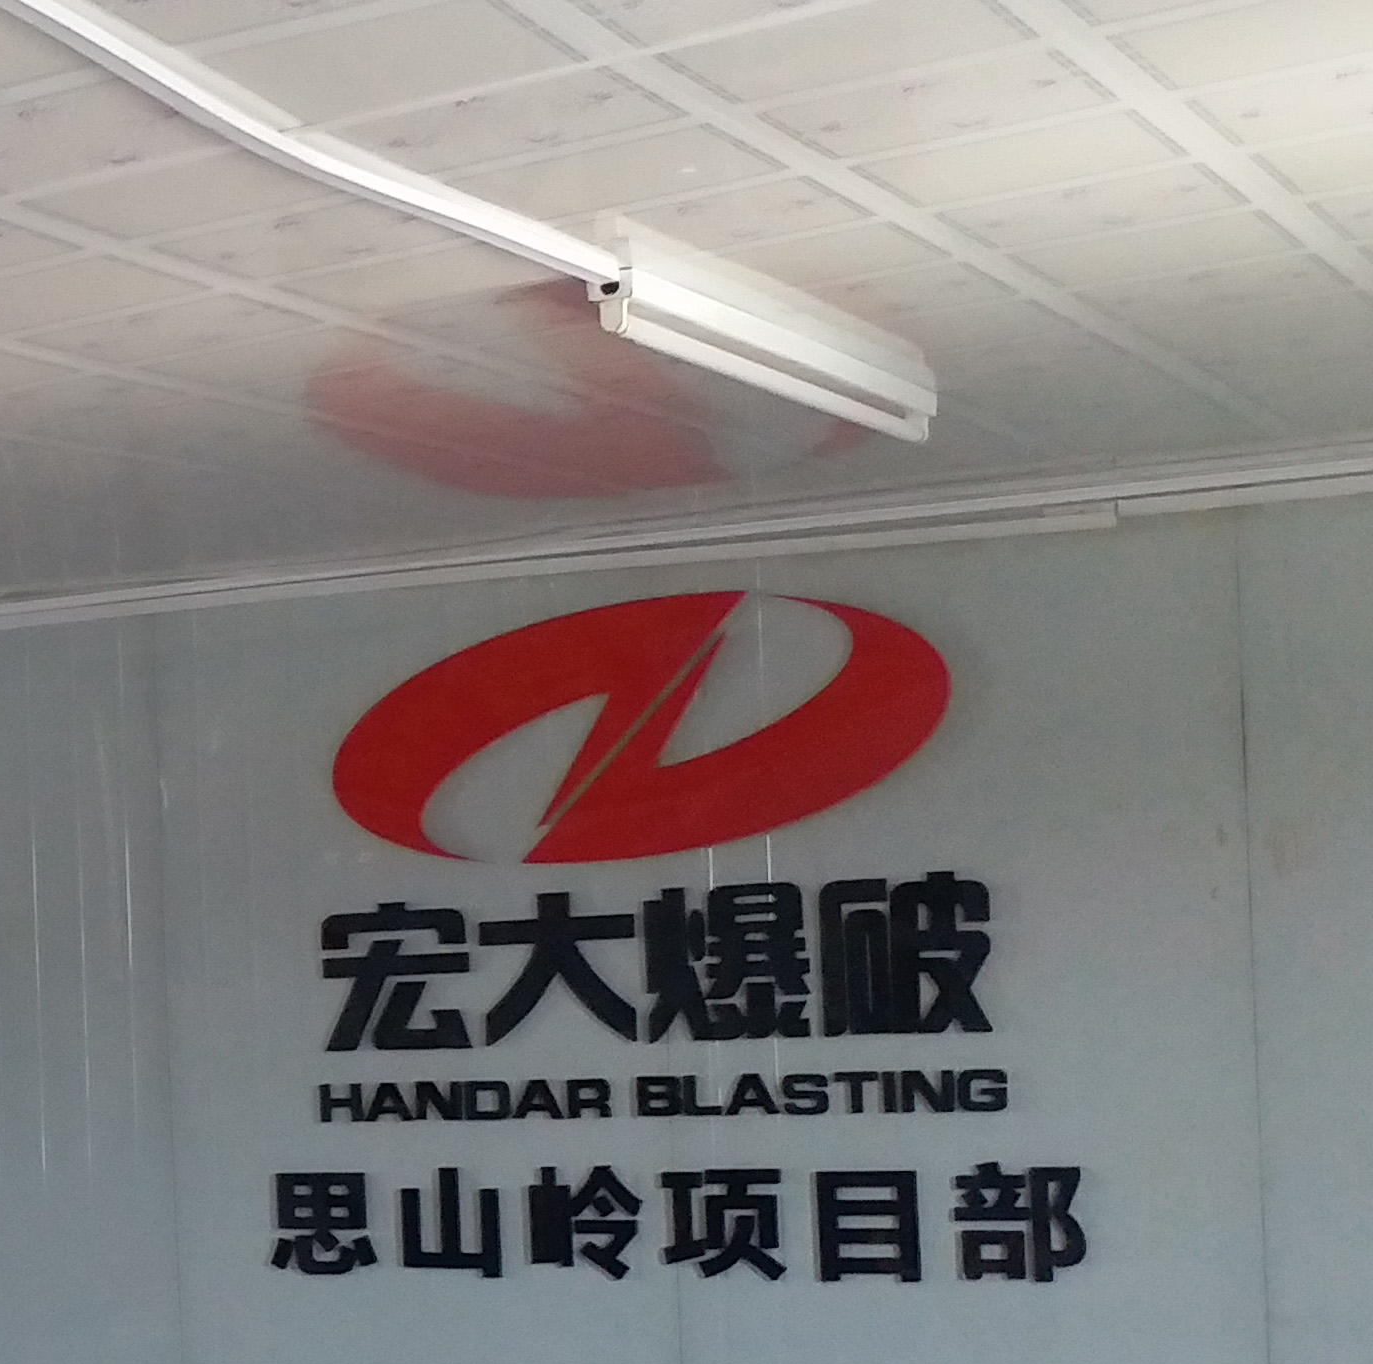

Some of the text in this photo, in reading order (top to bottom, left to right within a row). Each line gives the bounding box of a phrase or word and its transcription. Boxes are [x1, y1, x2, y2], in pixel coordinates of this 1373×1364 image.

[321, 871, 994, 1052] 宏大爆破
[318, 1069, 1009, 1122] HANDAR BLASTING
[270, 1162, 1088, 1282] 思山岭项目部
